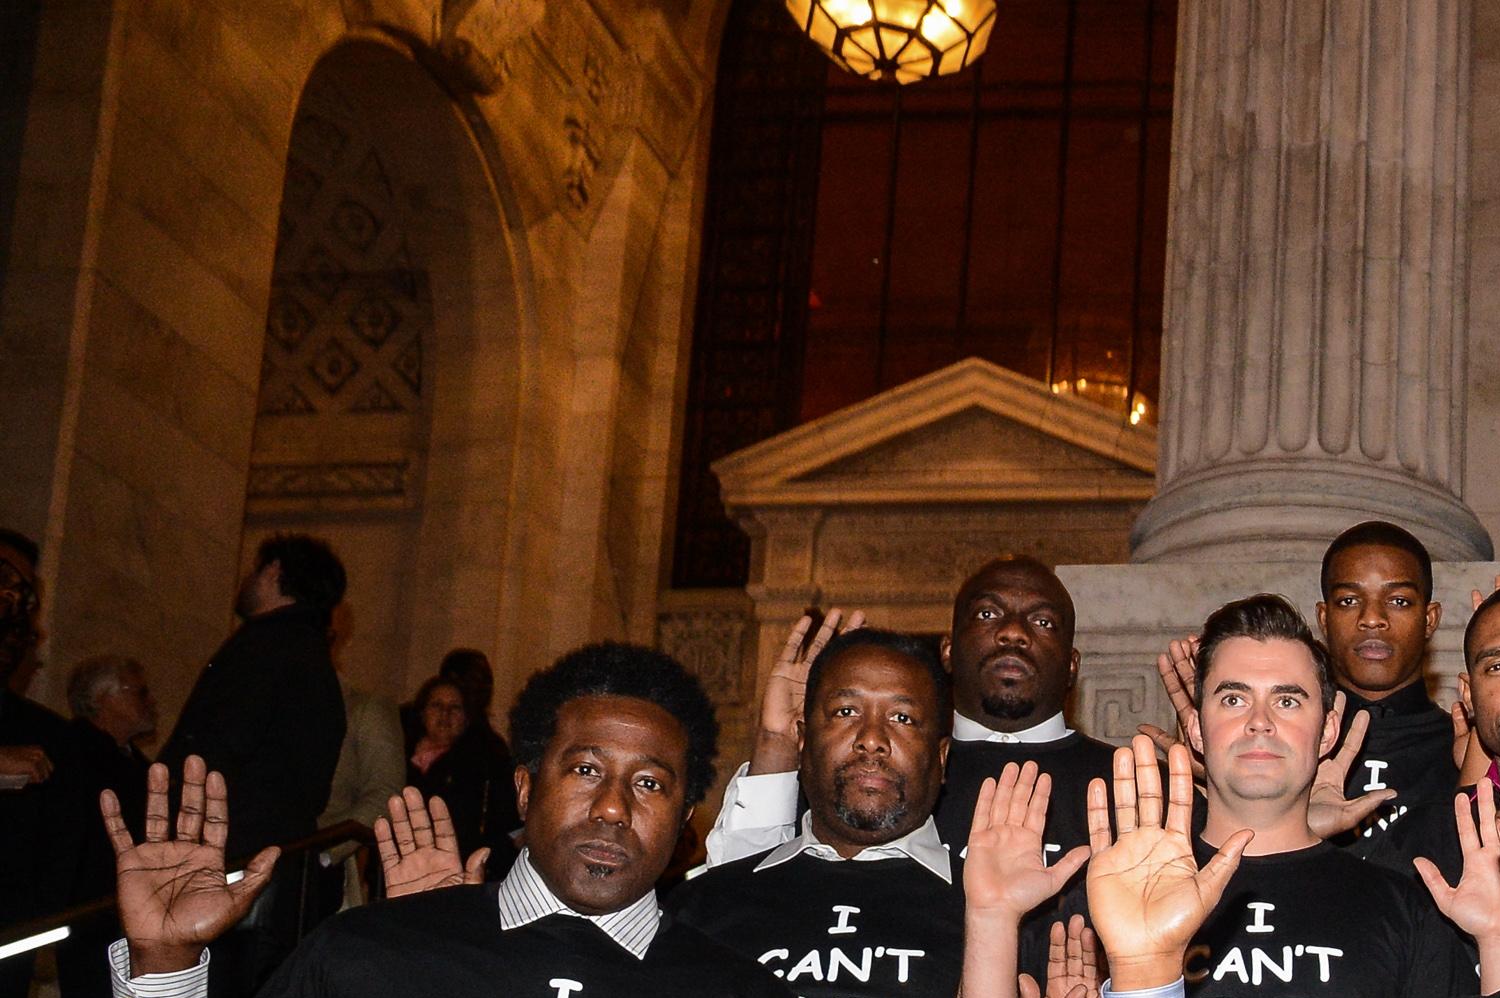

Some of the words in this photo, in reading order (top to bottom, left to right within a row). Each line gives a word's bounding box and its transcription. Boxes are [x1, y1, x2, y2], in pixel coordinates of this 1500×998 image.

[1363, 760, 1388, 792] I
[828, 905, 860, 934] I
[1246, 902, 1275, 933] I
